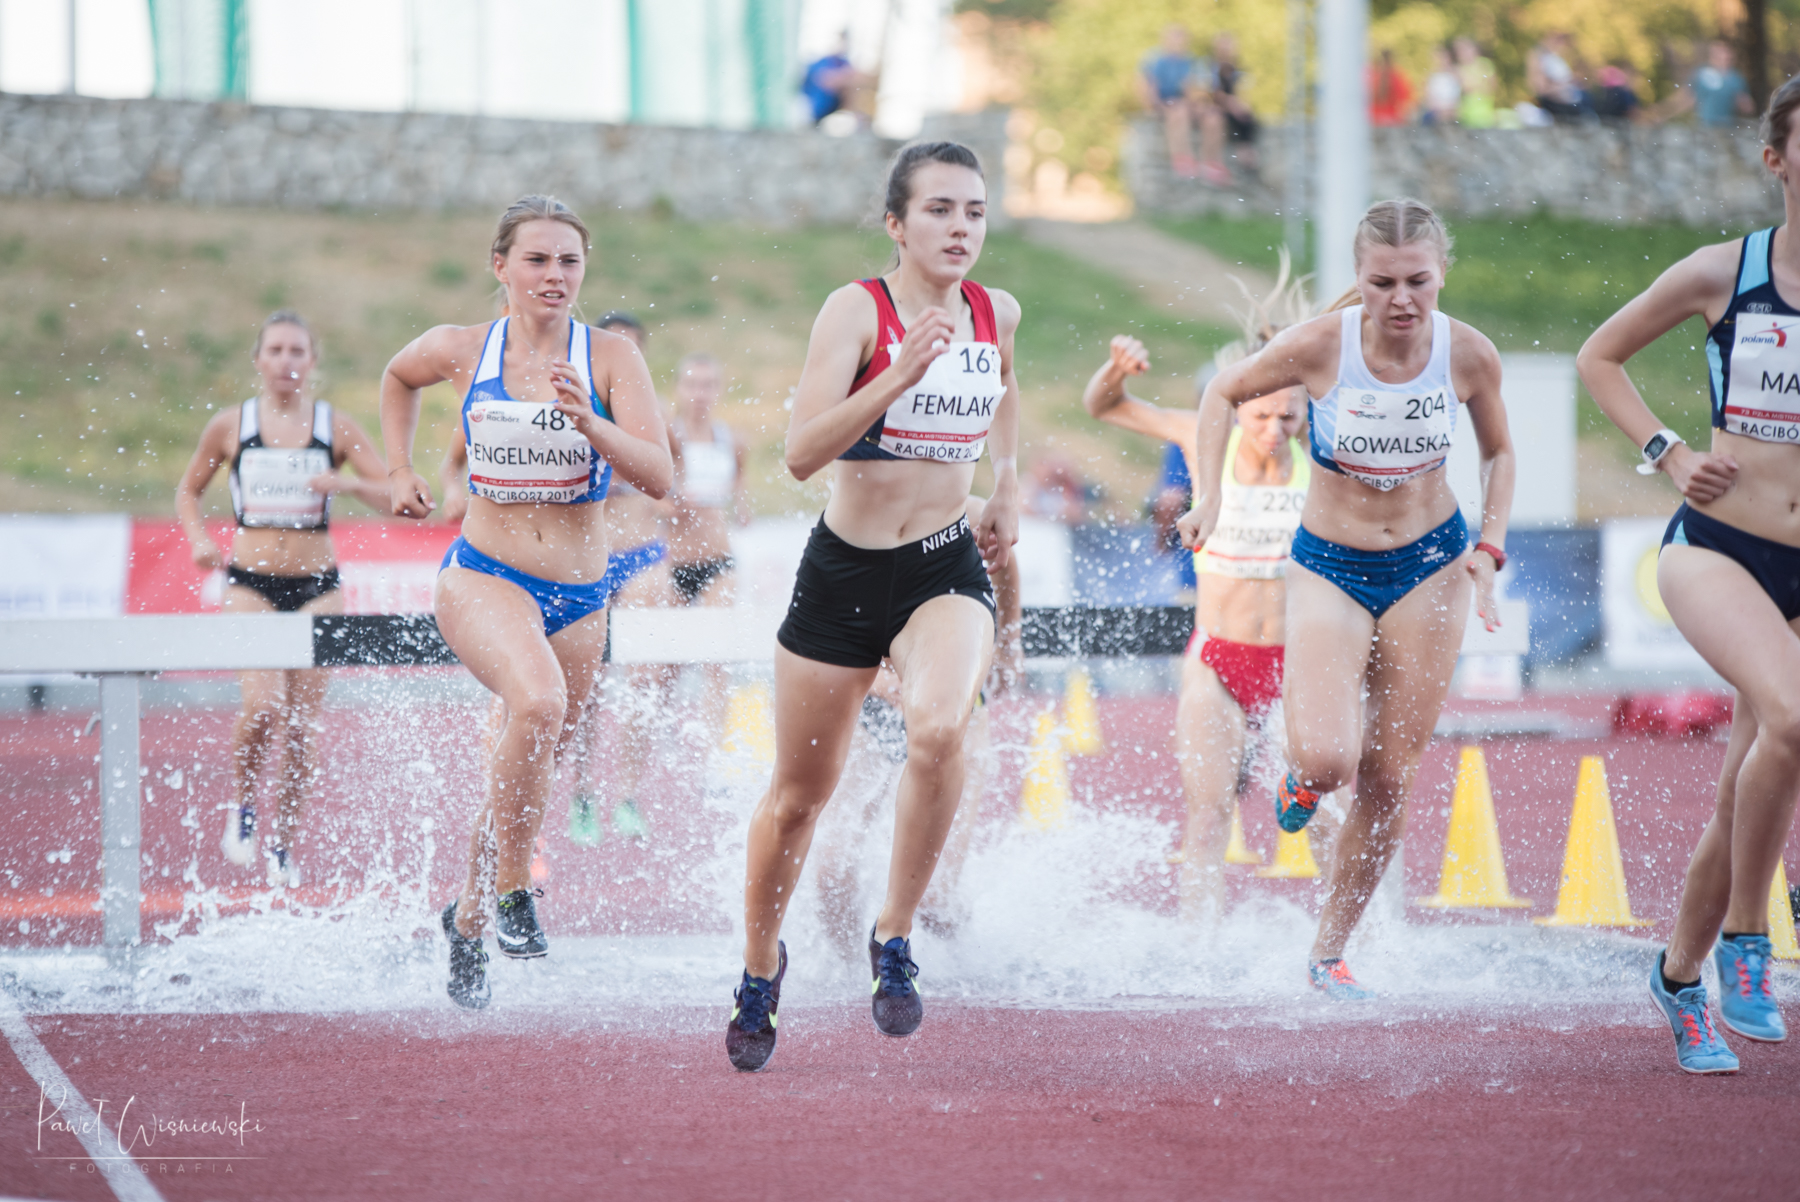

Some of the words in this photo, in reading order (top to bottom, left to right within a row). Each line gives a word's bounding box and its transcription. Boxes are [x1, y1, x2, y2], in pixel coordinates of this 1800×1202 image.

[1740, 334, 1776, 345] polanik
[911, 393, 995, 417] FEMLAK
[1405, 392, 1446, 420] 204
[486, 414, 520, 423] Racibórz
[531, 408, 577, 431] 48
[1741, 421, 1799, 440] RACIBÓ
[474, 442, 586, 466] ENGELMANN
[894, 442, 962, 459] RACIBÓRZ
[1337, 433, 1450, 454] KOWALSKA
[482, 487, 543, 501] RACIBÓRZ
[547, 489, 576, 501] 2019
[1263, 491, 1305, 512] 220
[921, 524, 960, 554] NIKE
